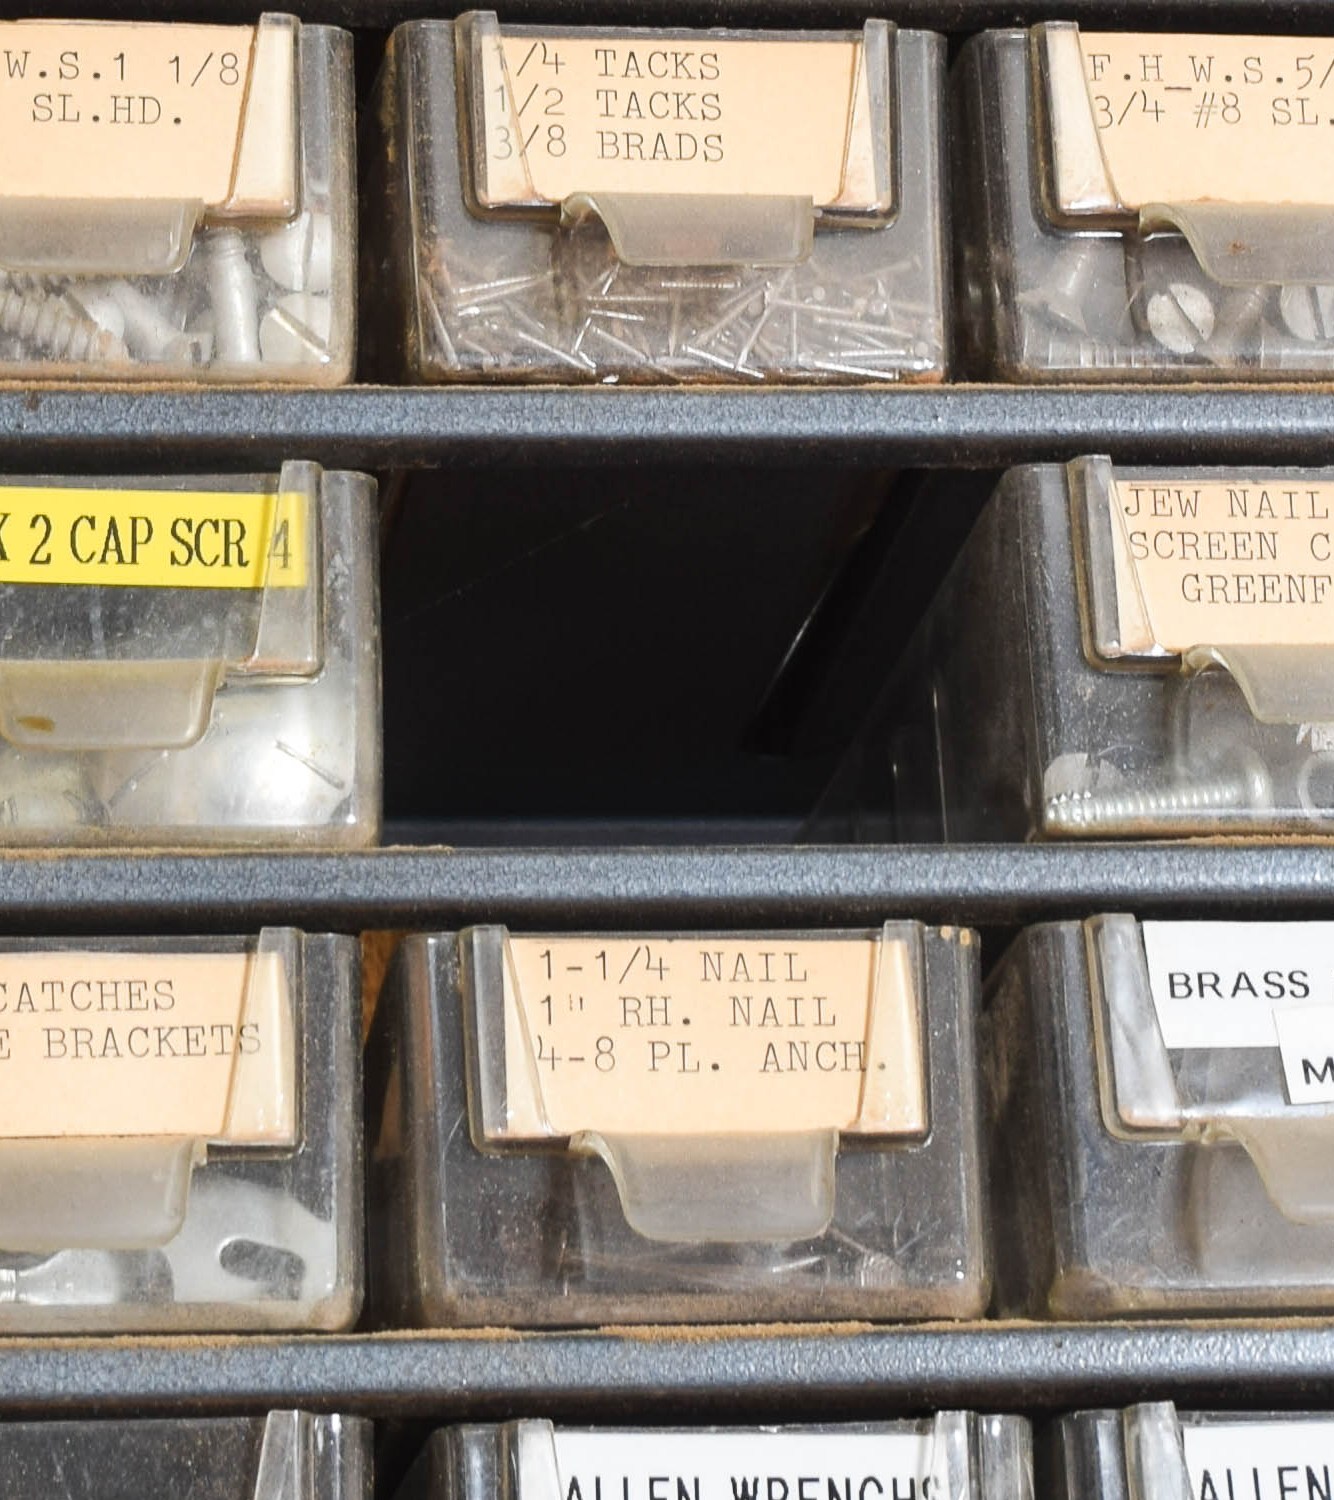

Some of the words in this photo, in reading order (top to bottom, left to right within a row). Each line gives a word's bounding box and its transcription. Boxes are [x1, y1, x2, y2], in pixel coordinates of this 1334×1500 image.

[168, 51, 240, 87] 1/8
[594, 48, 721, 80] TACKS
[595, 89, 722, 121] TACKS
[1094, 89, 1166, 129] 3/4
[1194, 91, 1242, 129] #8
[596, 131, 725, 162] BRADS
[1124, 488, 1202, 519] JEW
[1227, 489, 1330, 520] NAIL
[29, 513, 53, 565] 2
[69, 514, 154, 565] CAP
[170, 518, 250, 568] SCR
[1129, 531, 1280, 561] SCREEN
[539, 946, 671, 984] 1-1/4
[699, 951, 808, 982] NAIL
[1167, 969, 1311, 999] BRASS
[540, 994, 584, 1025] 1"
[620, 995, 692, 1028] RH.
[729, 996, 836, 1028] NAIL
[42, 1023, 262, 1060] BRACKETS
[537, 1035, 616, 1072] 4-8
[647, 1040, 720, 1072] PL.
